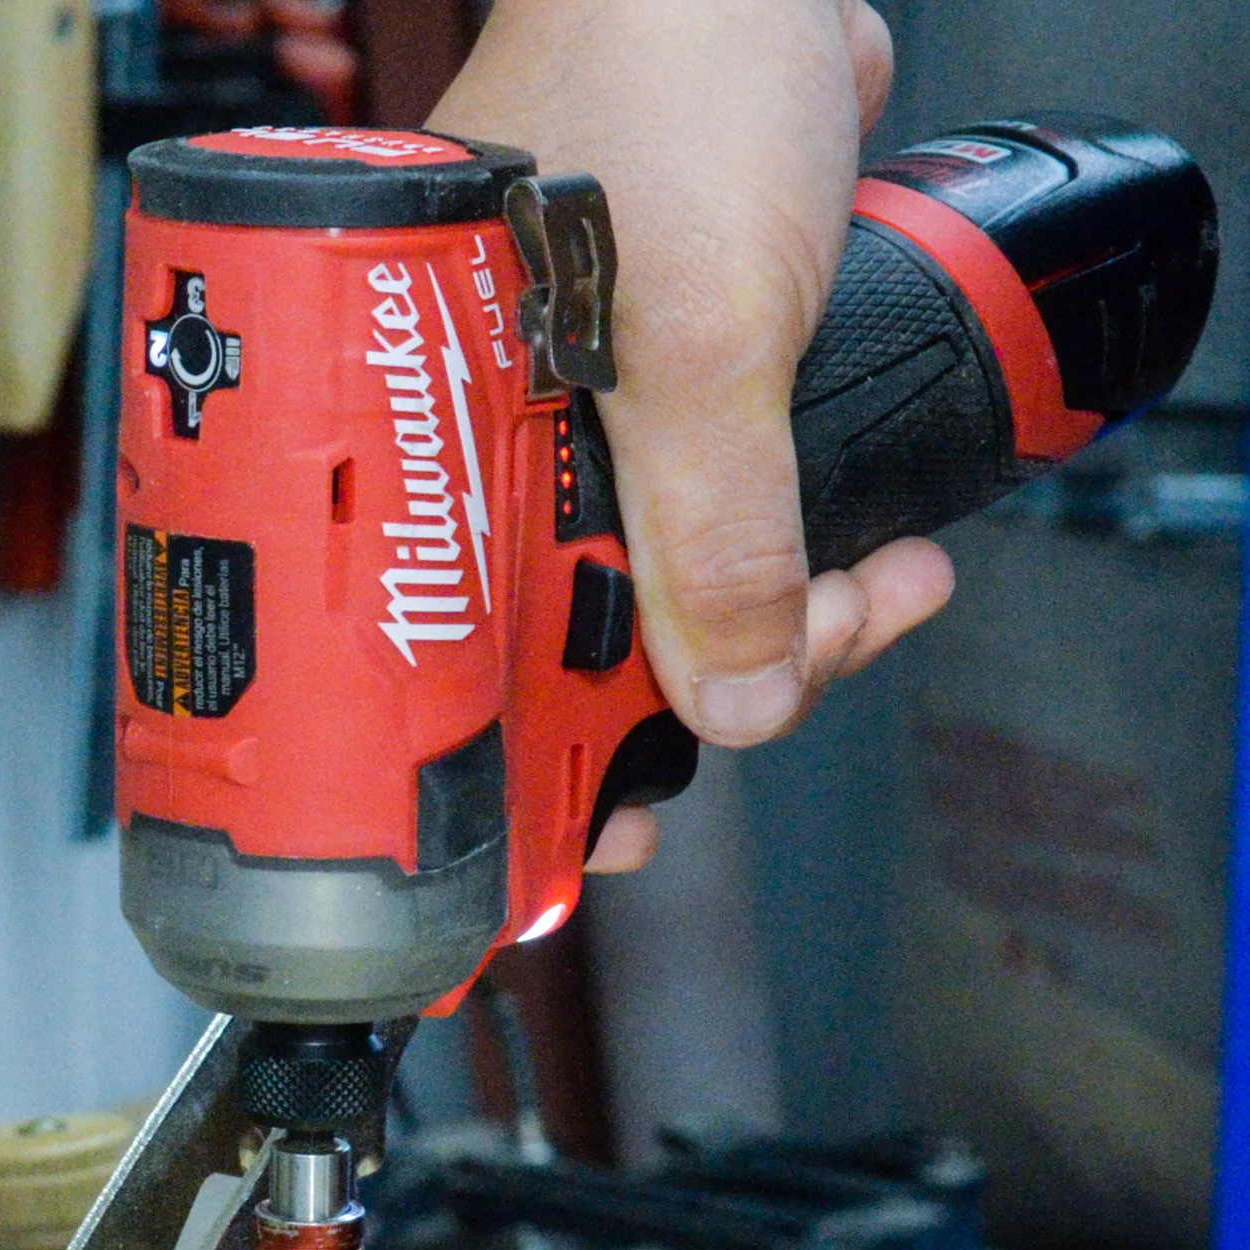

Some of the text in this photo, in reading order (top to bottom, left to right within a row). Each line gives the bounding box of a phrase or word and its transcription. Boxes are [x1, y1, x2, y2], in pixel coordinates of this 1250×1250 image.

[187, 277, 205, 313] 3
[471, 234, 513, 369] FUEL
[149, 330, 168, 368] 2
[187, 392, 202, 428] 1
[367, 261, 476, 667] Milwaukee
[178, 558, 190, 588] Para
